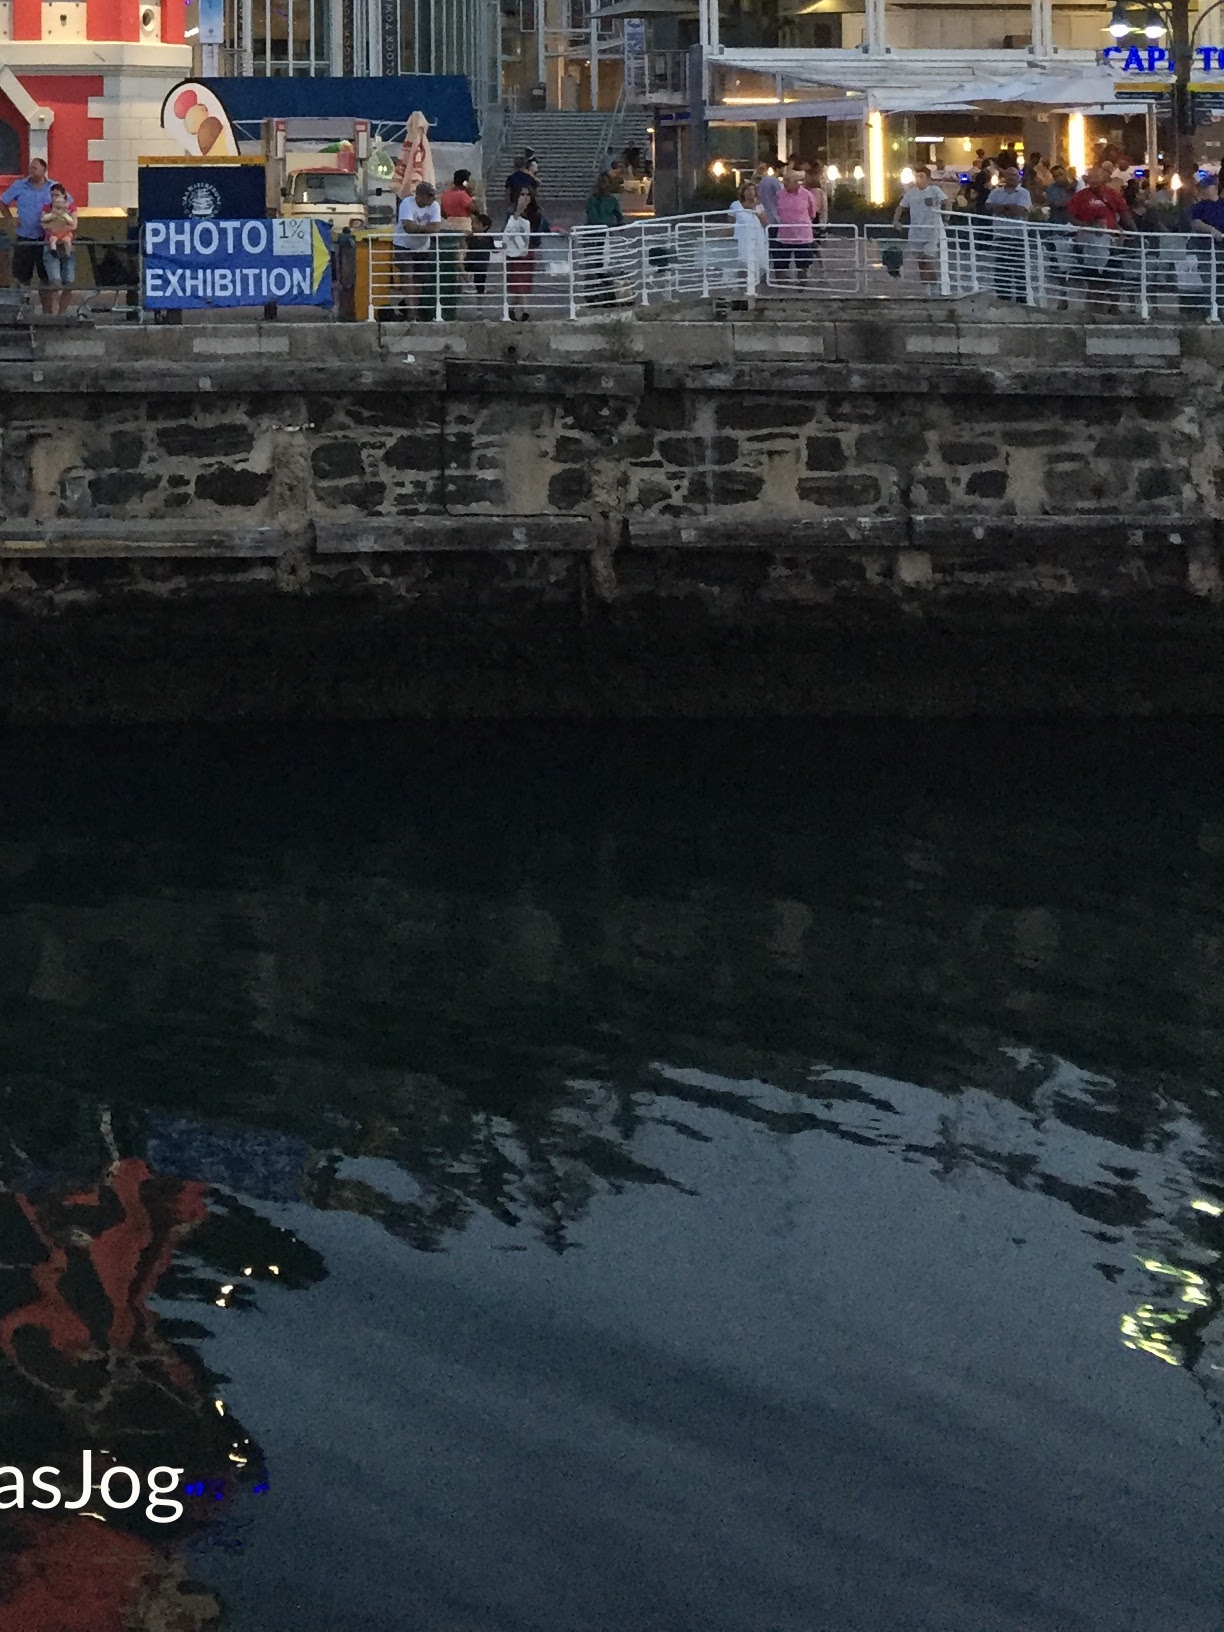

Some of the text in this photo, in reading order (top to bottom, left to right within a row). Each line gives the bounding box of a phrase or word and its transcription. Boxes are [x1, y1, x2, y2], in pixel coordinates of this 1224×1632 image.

[385, 35, 395, 76] CLOCK
[1102, 45, 1175, 72] CAP
[146, 221, 268, 255] PHOTO
[278, 219, 305, 239] 1%
[146, 268, 311, 297] EXHIBITION
